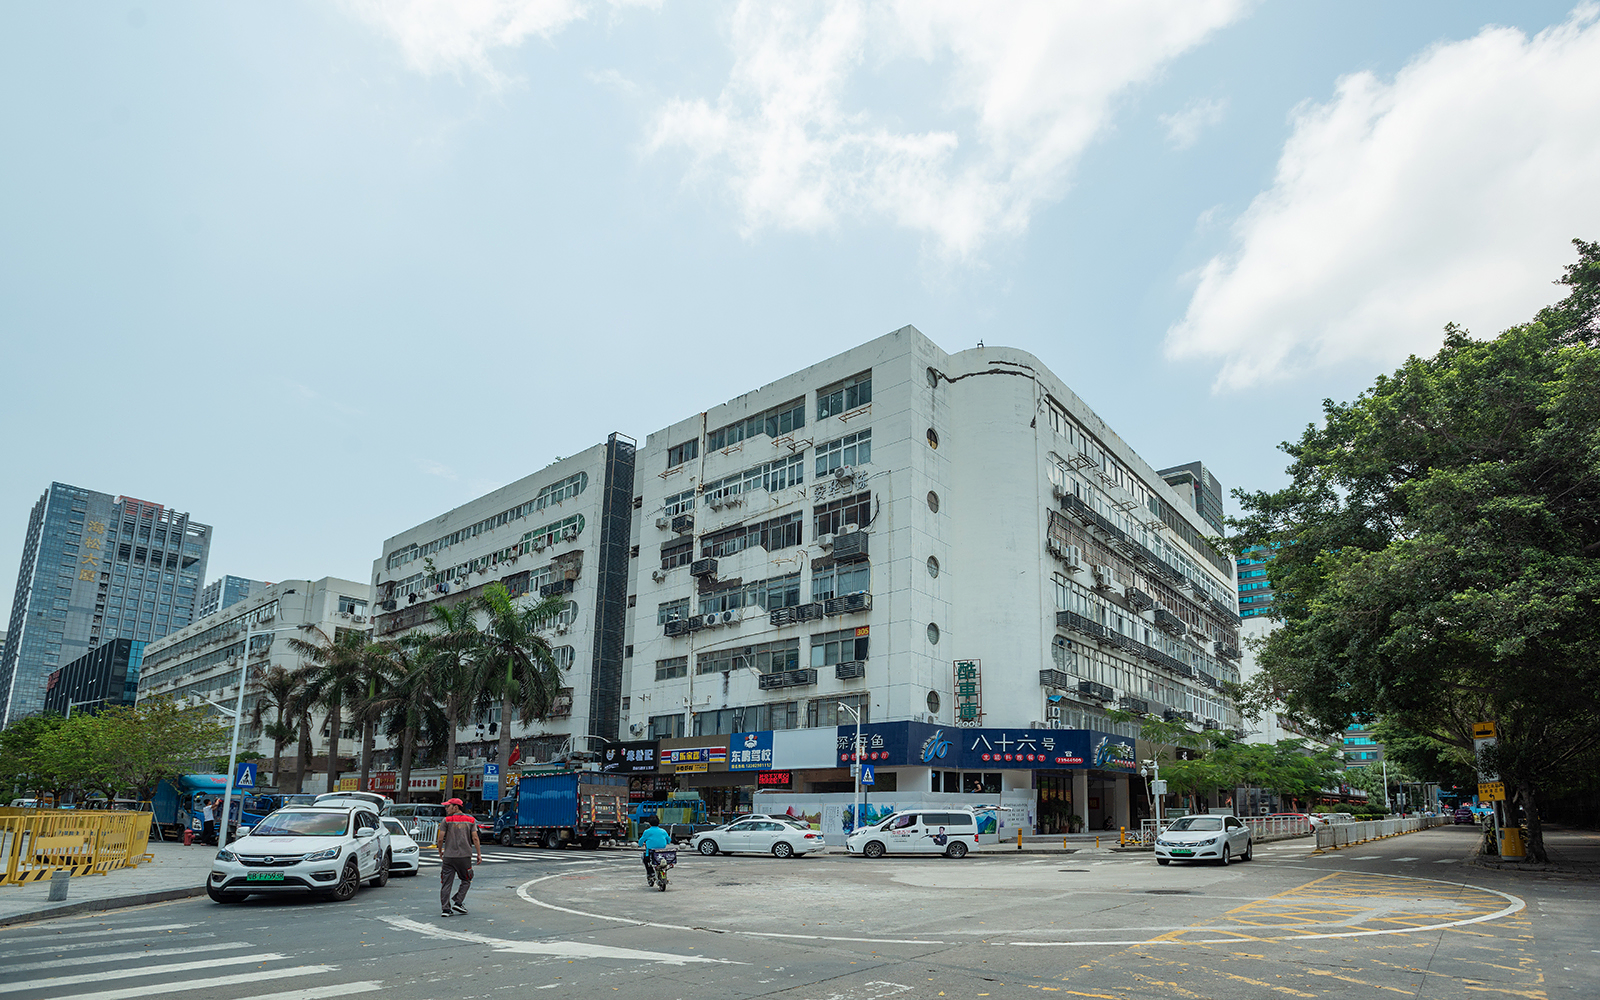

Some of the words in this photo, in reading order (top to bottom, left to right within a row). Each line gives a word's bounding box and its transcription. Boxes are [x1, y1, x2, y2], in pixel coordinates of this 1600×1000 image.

[78, 520, 105, 583] 海松大厦
[856, 627, 869, 636] 305
[957, 661, 978, 719] 酷車庫
[971, 733, 1056, 752] 八十六号
[731, 749, 771, 762] 东鹏驾校
